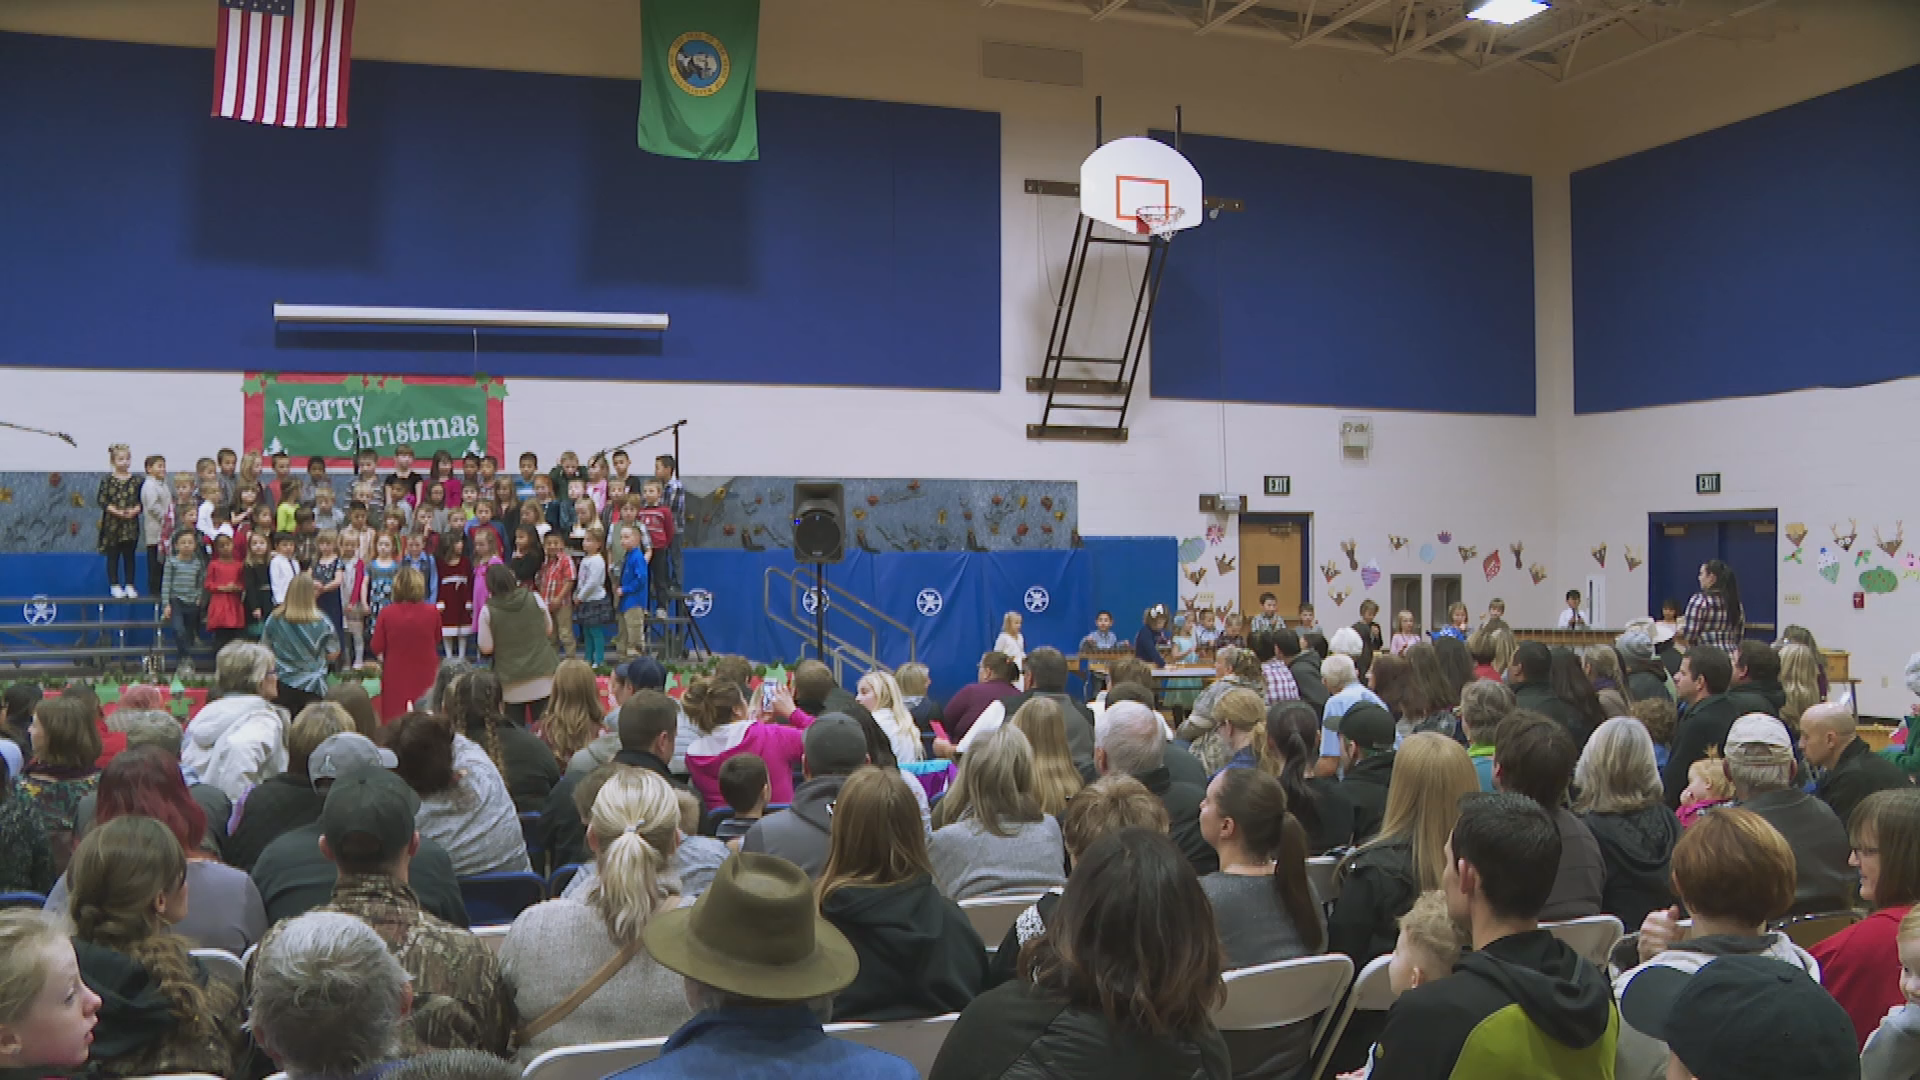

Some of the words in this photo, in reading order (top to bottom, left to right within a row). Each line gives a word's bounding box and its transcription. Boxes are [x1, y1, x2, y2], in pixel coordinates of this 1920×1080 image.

[276, 395, 364, 426] Merry
[333, 414, 480, 451] Christmas
[1269, 478, 1288, 492] EXIT
[1700, 476, 1717, 490] EXIT
